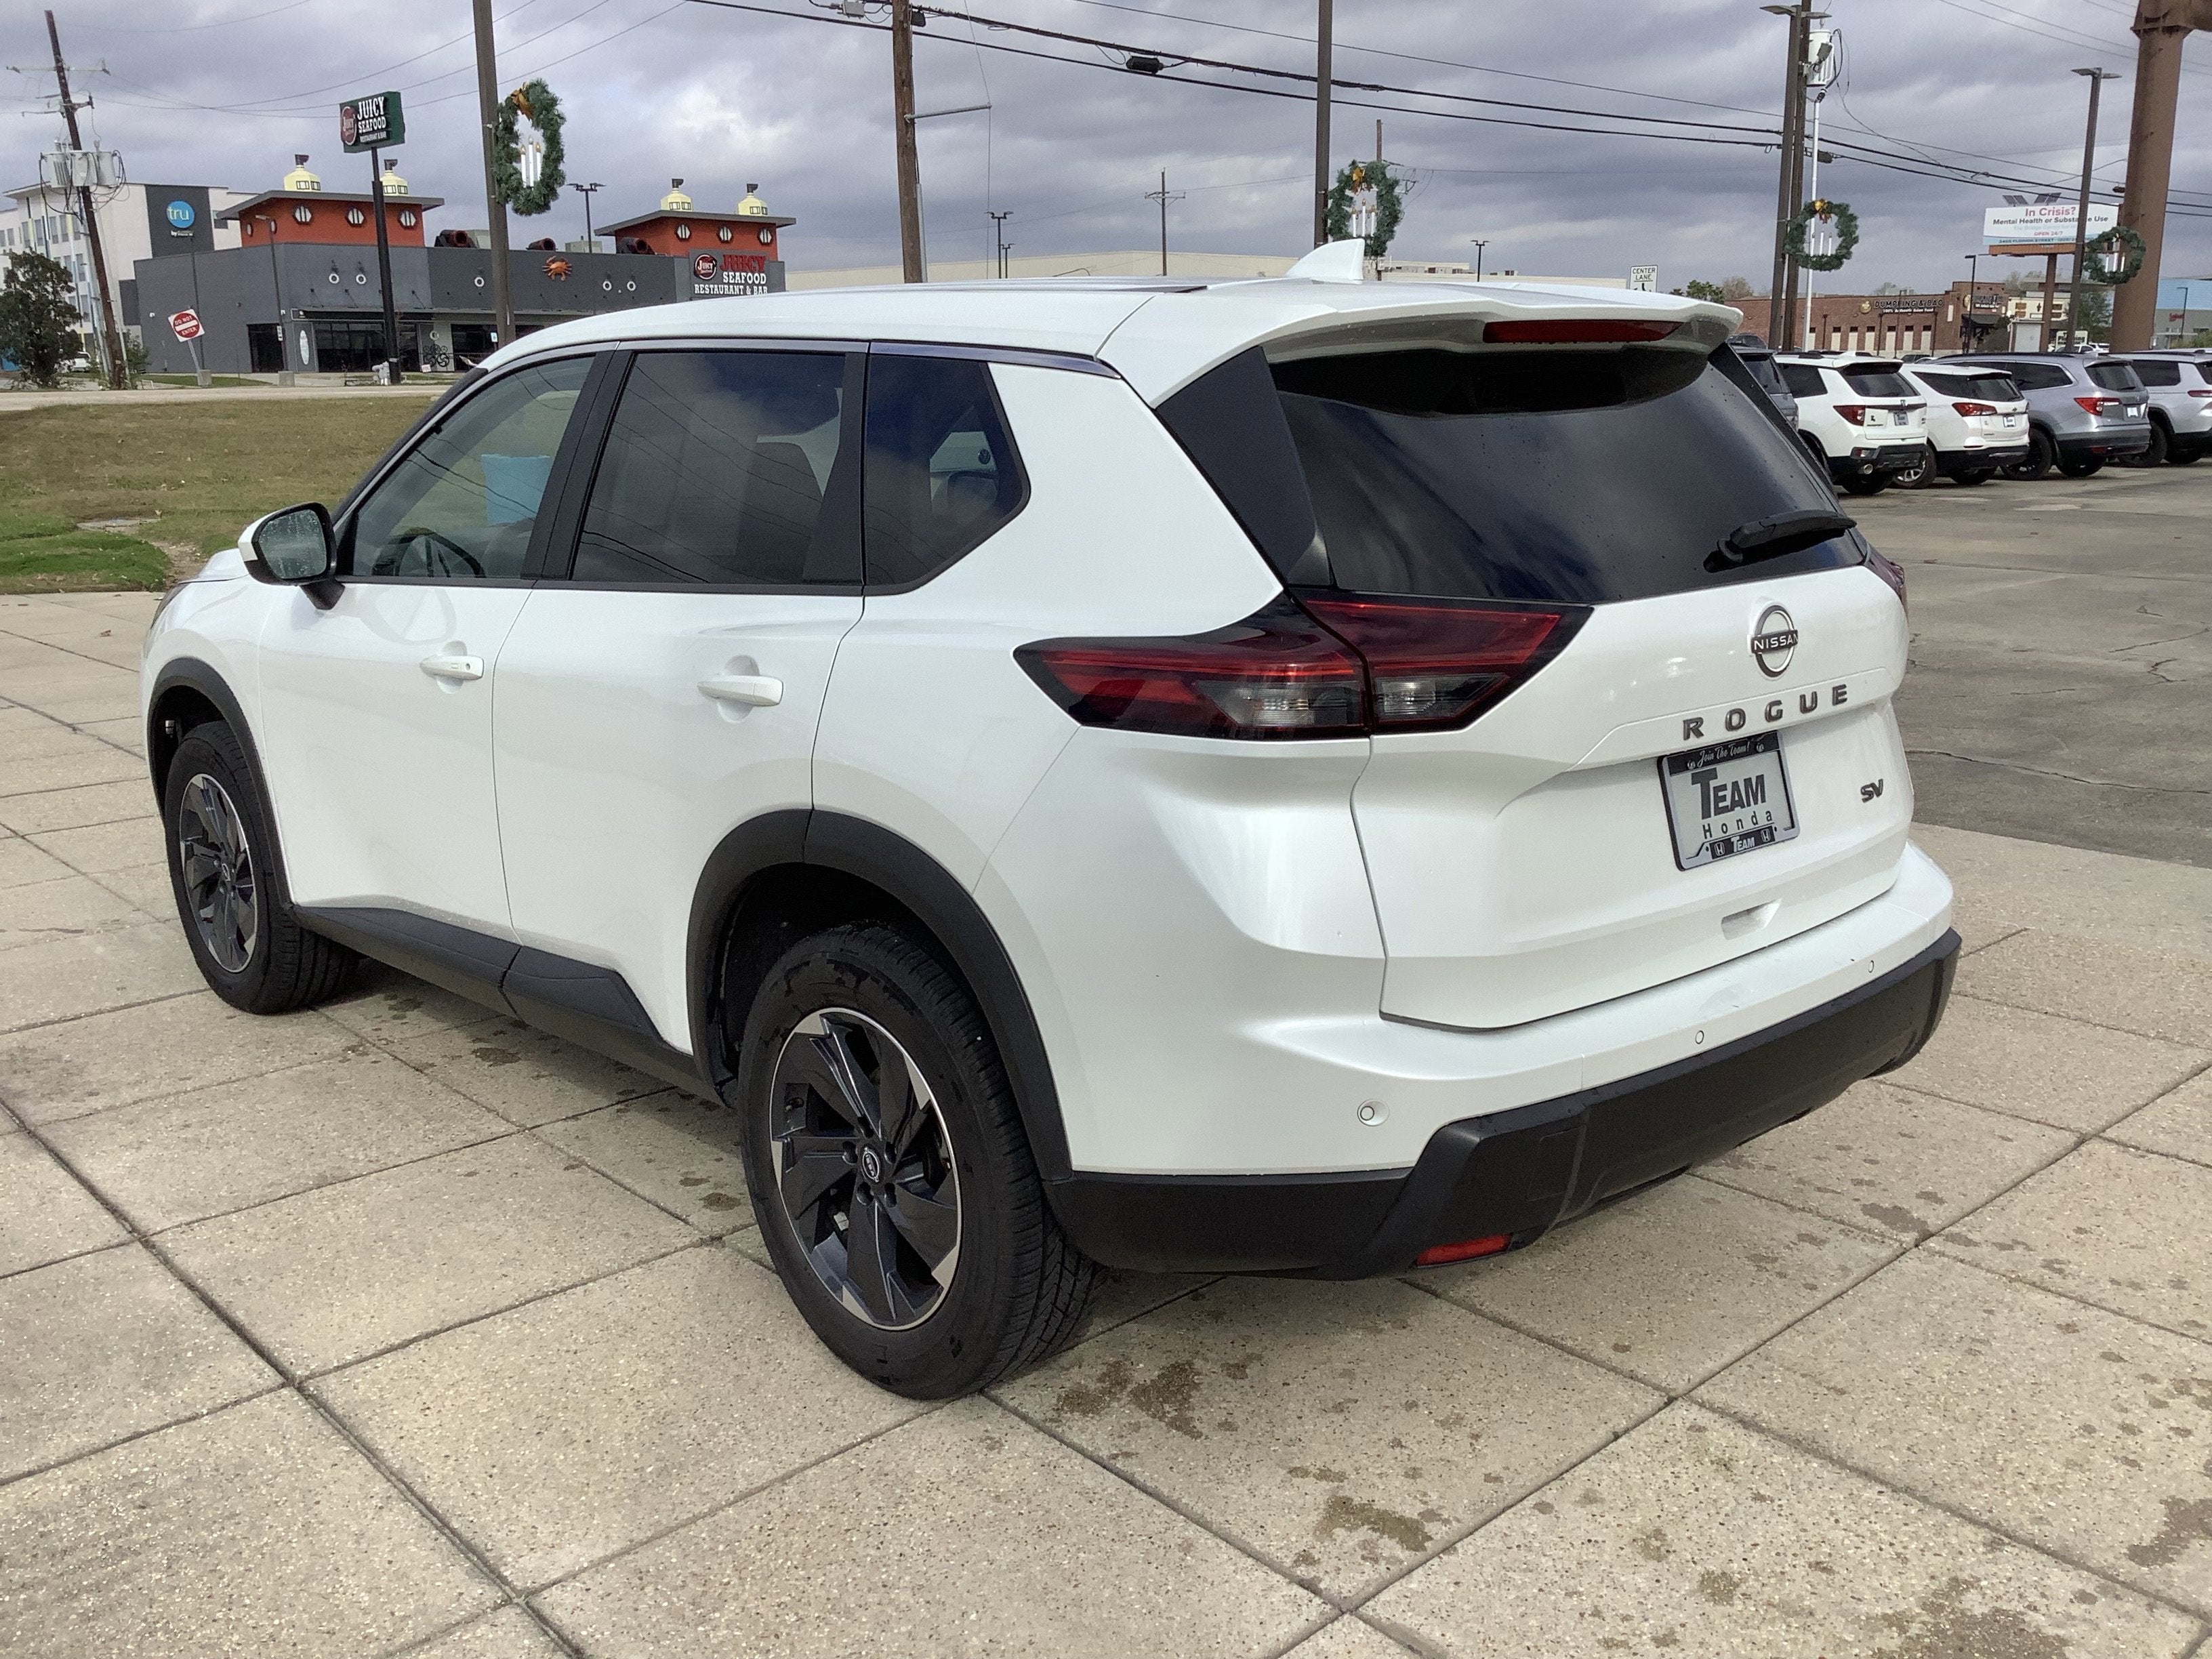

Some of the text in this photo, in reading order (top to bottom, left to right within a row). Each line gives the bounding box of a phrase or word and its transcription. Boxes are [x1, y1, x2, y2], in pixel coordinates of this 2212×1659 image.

[357, 96, 384, 120] JUICY
[358, 116, 386, 134] SEAFOOD
[167, 206, 189, 220] tru
[2025, 207, 2076, 217] In Crisis?
[723, 272, 766, 284] SEAFOOD
[695, 284, 768, 295] RESTAURANT & BAR
[1927, 299, 1944, 307] BAO
[181, 327, 197, 335] ENTER
[1754, 631, 1798, 651] NISSAN
[1683, 684, 1847, 741] ROGUE
[1698, 750, 1715, 768] Join
[1691, 767, 1766, 820] TEAM
[1860, 779, 1884, 803] SV
[1702, 811, 1773, 840] Honda
[1731, 836, 1755, 853] TEAM
